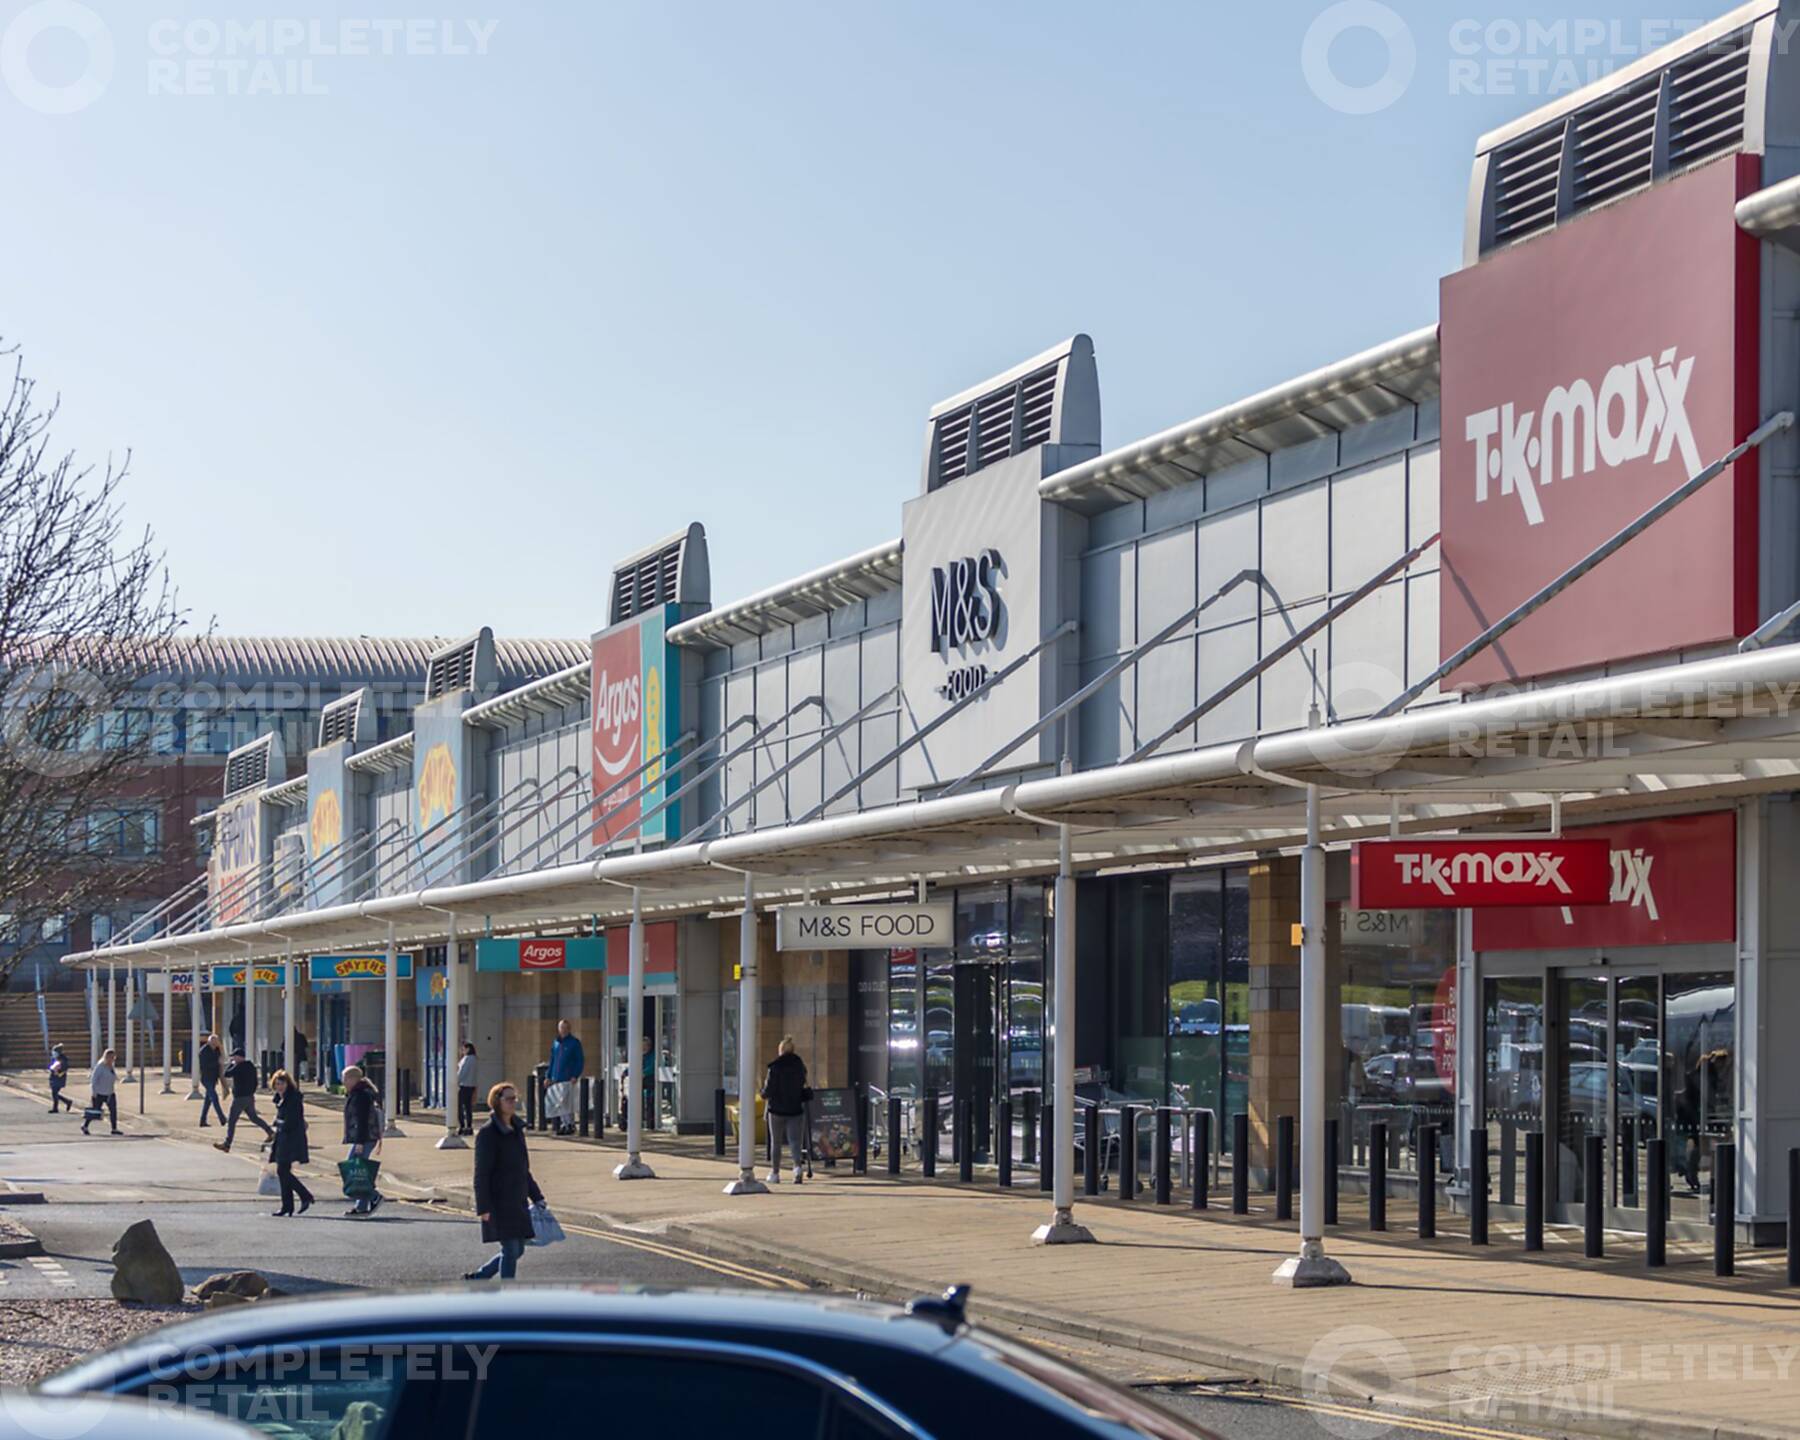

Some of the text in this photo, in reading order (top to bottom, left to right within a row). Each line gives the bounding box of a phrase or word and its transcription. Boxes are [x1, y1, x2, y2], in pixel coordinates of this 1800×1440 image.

[931, 548, 1001, 652] M&S
[595, 670, 640, 746] Argos
[800, 915, 934, 937] M&S FOOD
[523, 944, 562, 960] Argos
[335, 959, 386, 976] SMYTHS
